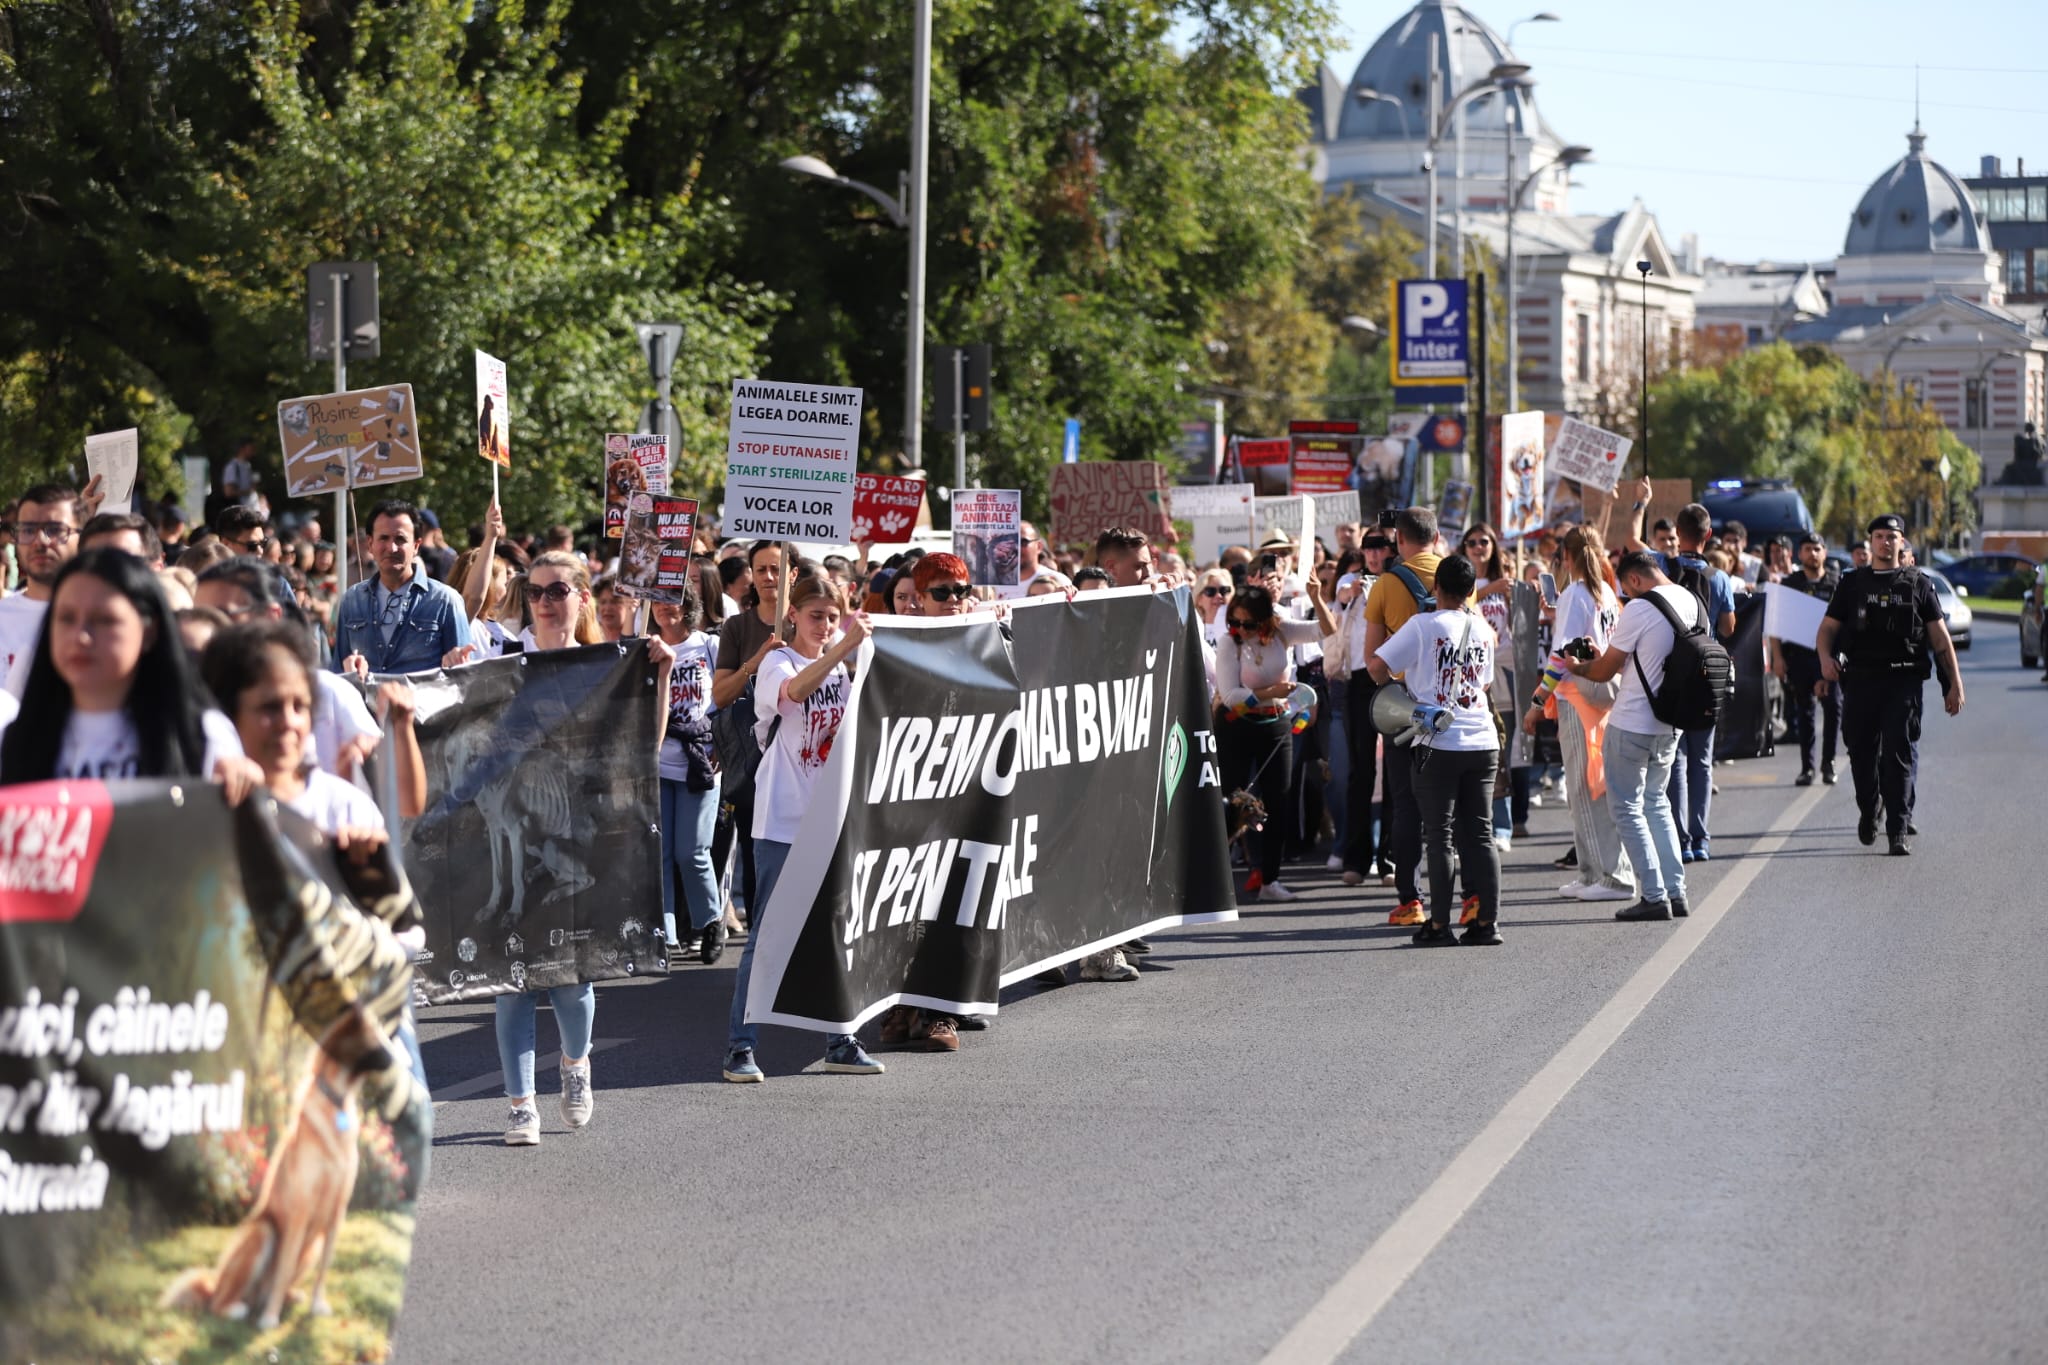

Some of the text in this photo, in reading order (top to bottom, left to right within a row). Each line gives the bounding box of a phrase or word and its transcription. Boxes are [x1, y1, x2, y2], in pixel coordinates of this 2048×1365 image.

[1404, 283, 1449, 338] P
[1406, 340, 1459, 360] Inter
[736, 385, 858, 407] ANIMALELE SIMT.
[738, 405, 853, 426] LEGEA DOARME.
[630, 435, 667, 449] ANIMALELE
[737, 442, 770, 455] STOP
[772, 444, 842, 460] EUTANASIE
[728, 464, 768, 478] START
[769, 466, 847, 483] STERILIZARE
[883, 479, 921, 493] CARD
[743, 496, 833, 516] VOCEA LOR
[955, 501, 1018, 513] MALTRATEAZĂ
[976, 494, 998, 503] CINE
[657, 513, 691, 525] NU ARE
[961, 512, 1012, 523] ANIMALE
[659, 526, 690, 538] SCUZE.
[733, 518, 839, 539] SUNTEM NOI.
[867, 712, 996, 805] VREM
[1017, 685, 1071, 773] MAI
[86, 985, 229, 1056] câinele
